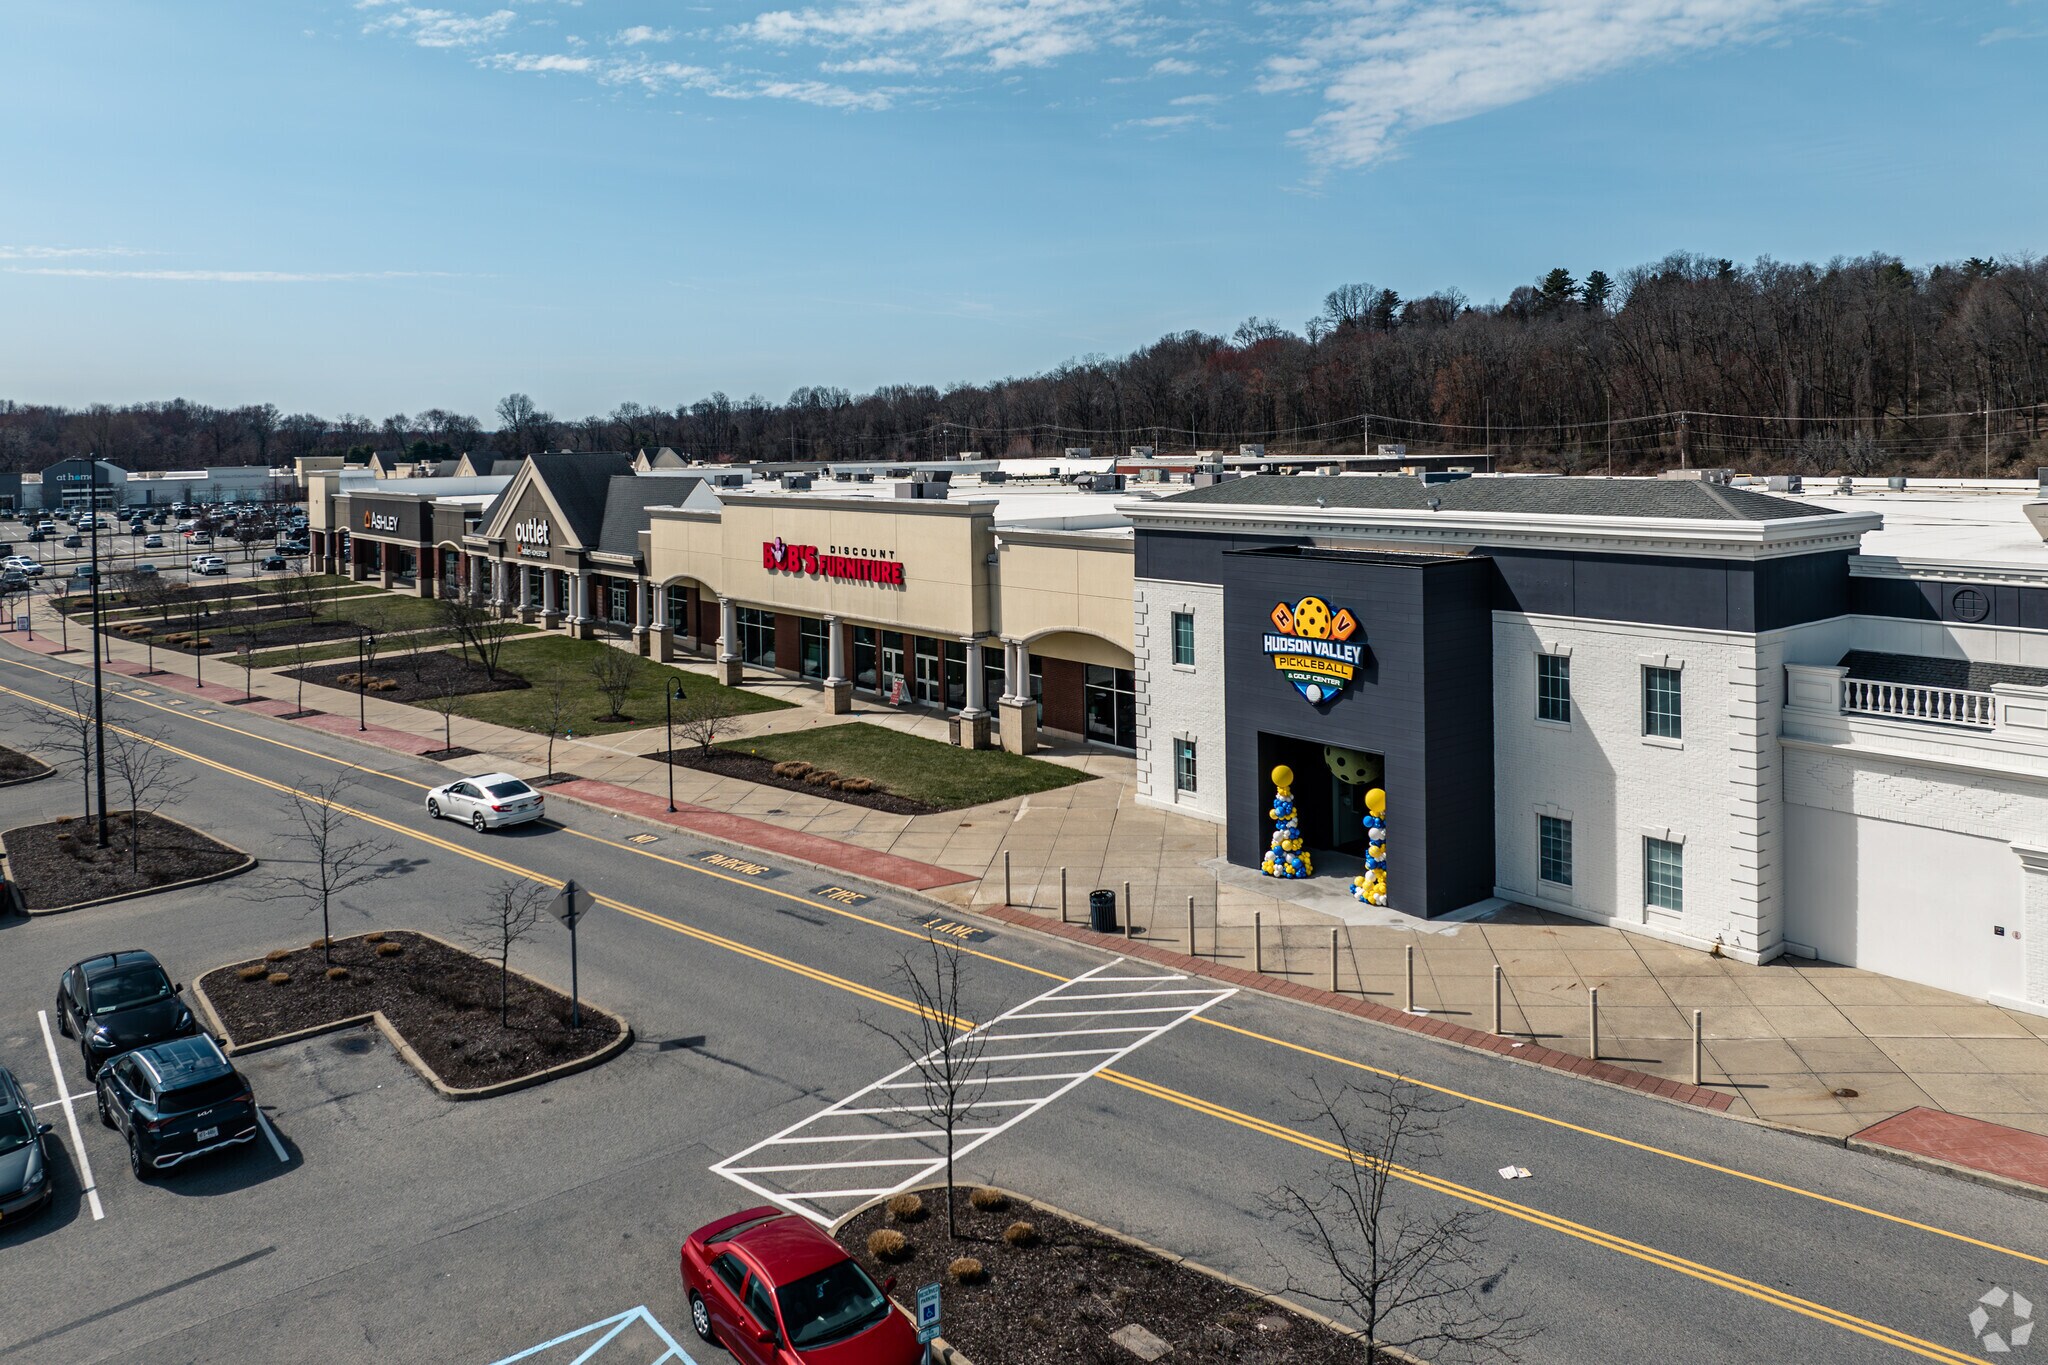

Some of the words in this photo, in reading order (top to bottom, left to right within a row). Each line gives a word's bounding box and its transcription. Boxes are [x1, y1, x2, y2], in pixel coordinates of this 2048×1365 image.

[56, 473, 66, 481] at
[371, 511, 399, 531] ASHLEY
[515, 517, 549, 545] outlet
[830, 545, 895, 559] DISCOUNT
[819, 554, 904, 585] FURNITURE
[1275, 609, 1290, 627] H
[1336, 615, 1351, 633] V
[1264, 635, 1312, 655] HUDSON
[1313, 641, 1361, 665] VALLEY
[1279, 657, 1348, 675] PICKLEBALL
[1312, 675, 1341, 686] CENTER
[700, 853, 770, 875] PARKING
[817, 886, 867, 905] FIRE
[922, 918, 985, 940] LANE
[920, 1294, 938, 1305] PARKING
